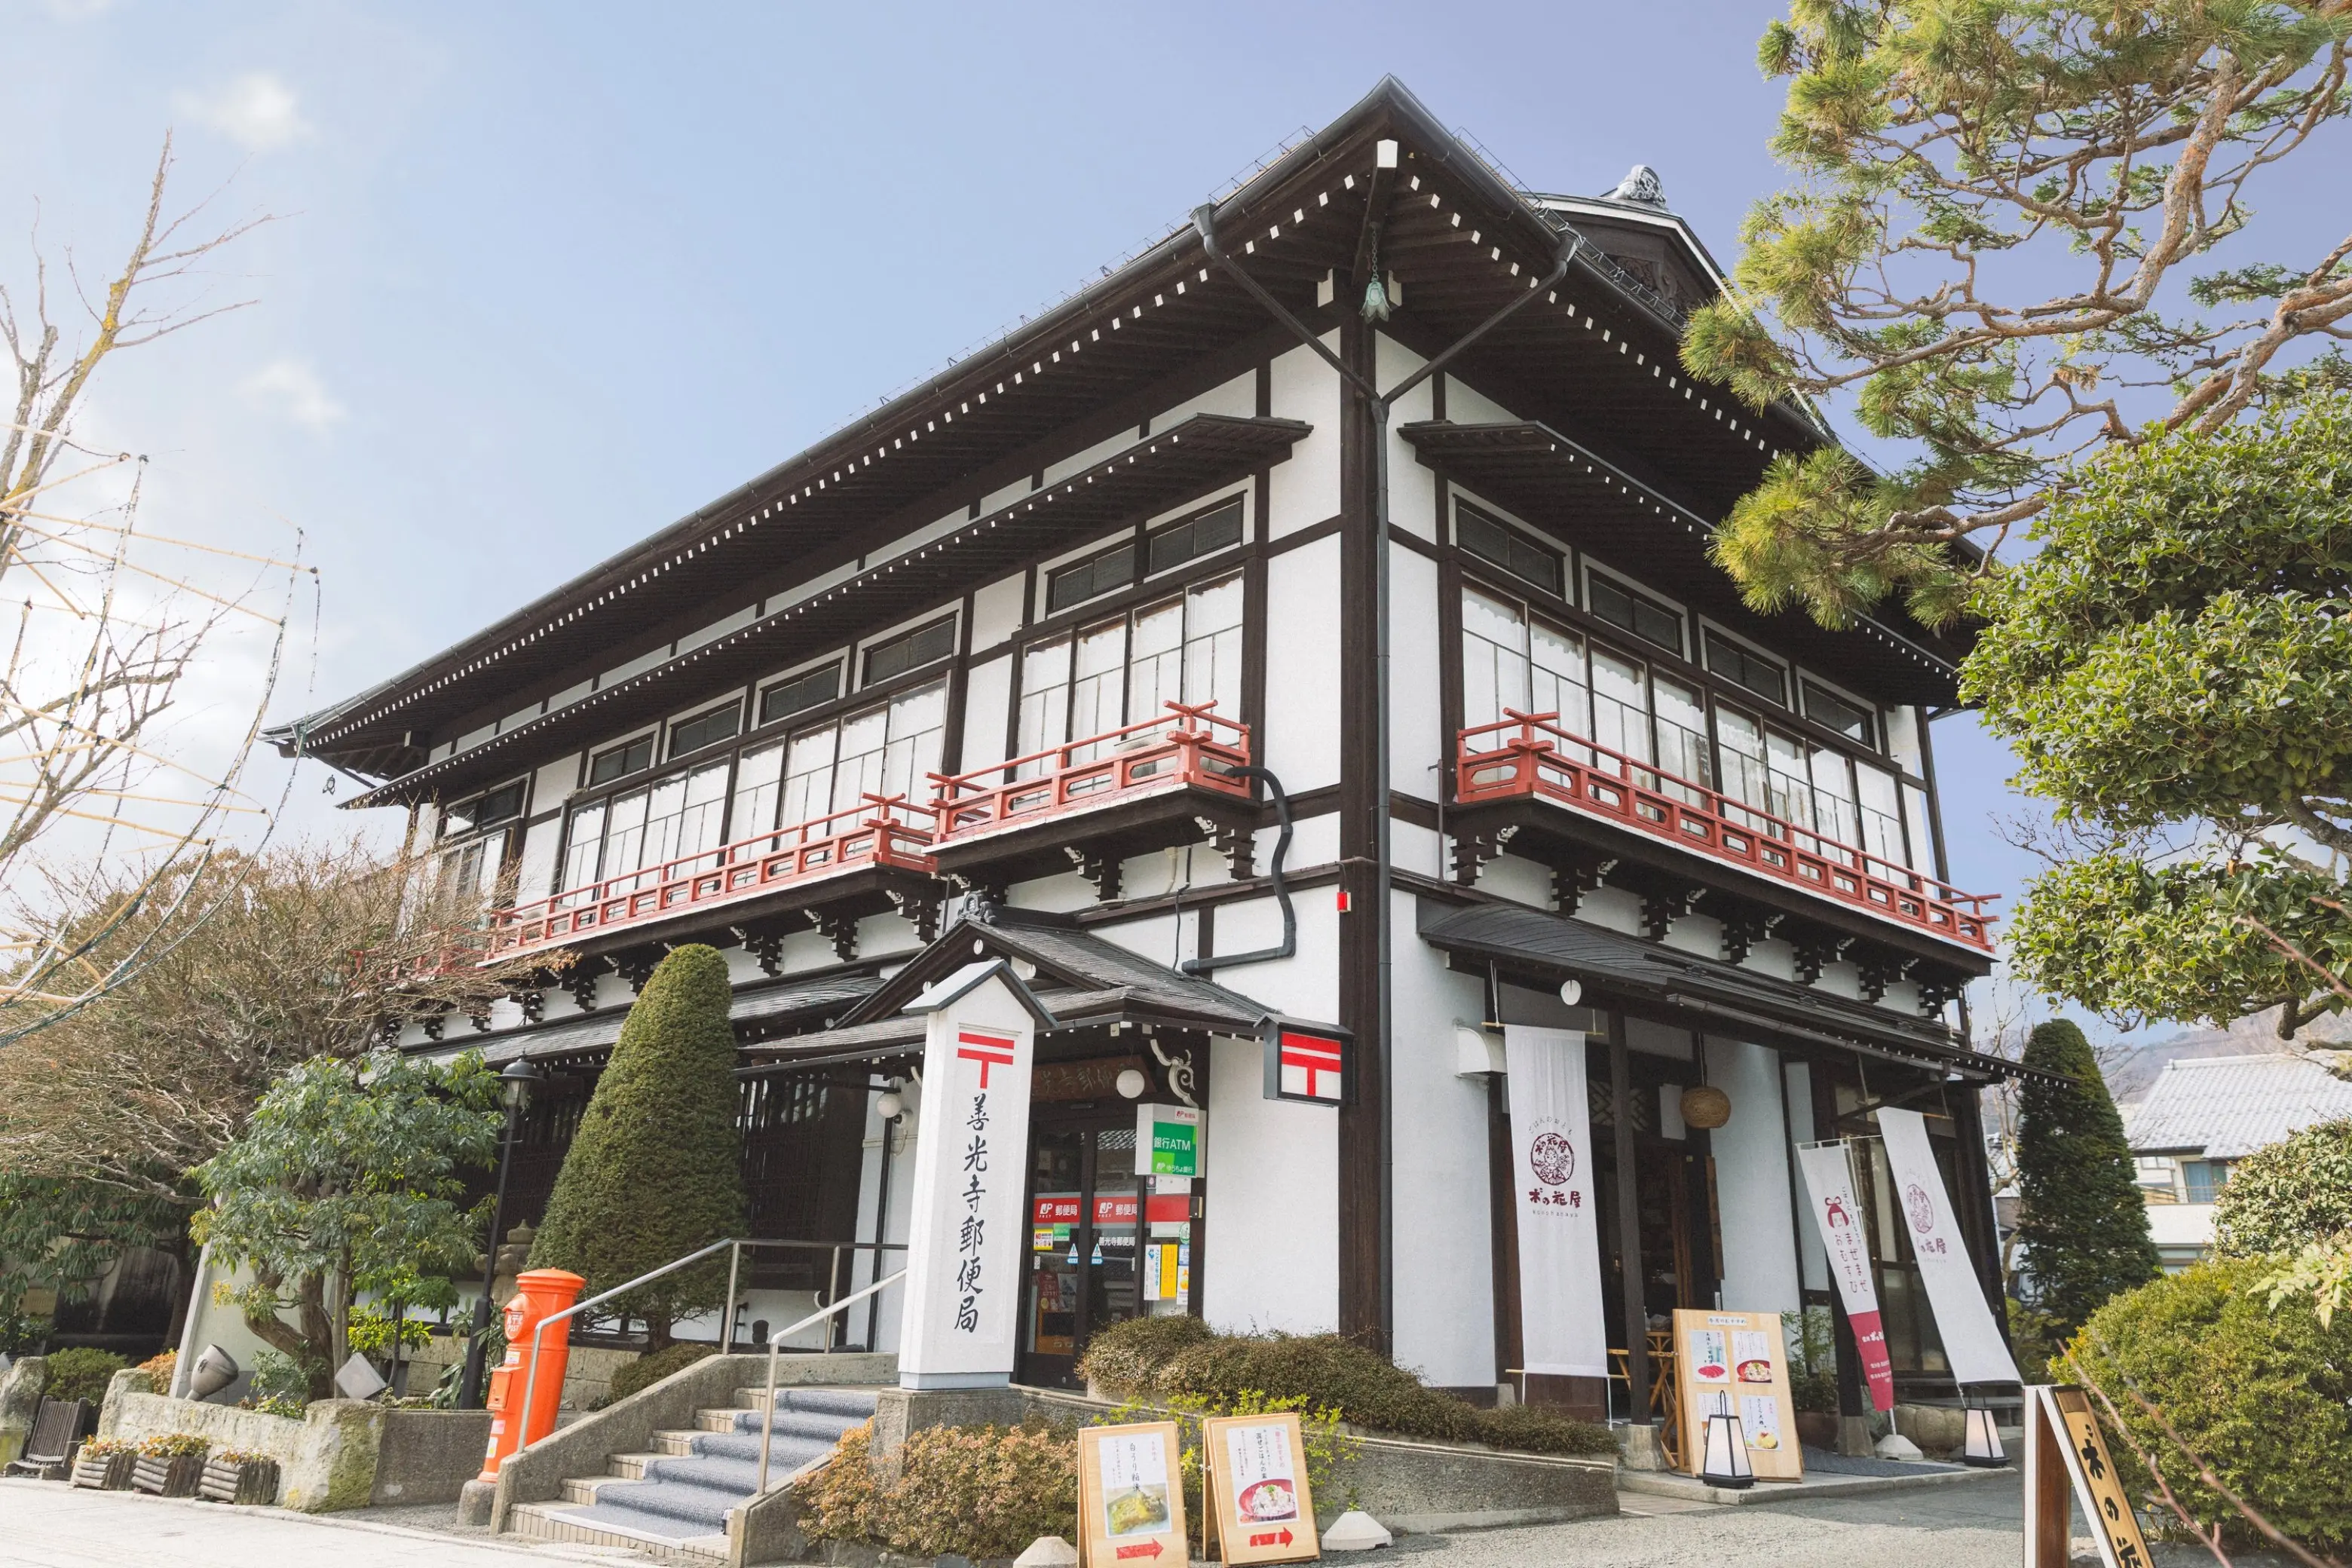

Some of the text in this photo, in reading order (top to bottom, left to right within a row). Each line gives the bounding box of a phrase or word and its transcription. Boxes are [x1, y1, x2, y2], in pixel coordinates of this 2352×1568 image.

[1154, 1137, 1191, 1151] 銀行ATM
[1166, 1164, 1193, 1174] ゆうちょ銀行
[1529, 1188, 1582, 1208] 木の花屋
[954, 1092, 990, 1334] 善光寺郵便局
[1055, 1205, 1078, 1216] 郵便局
[1116, 1204, 1138, 1216] 郵便局
[1098, 1236, 1135, 1246] 善光寺郵便局
[1916, 1238, 1947, 1254] の花屋
[1834, 1233, 1857, 1294] おむすび
[1845, 1231, 1868, 1292] まぜまぜ
[1129, 1442, 1141, 1492] 白うり粕漬
